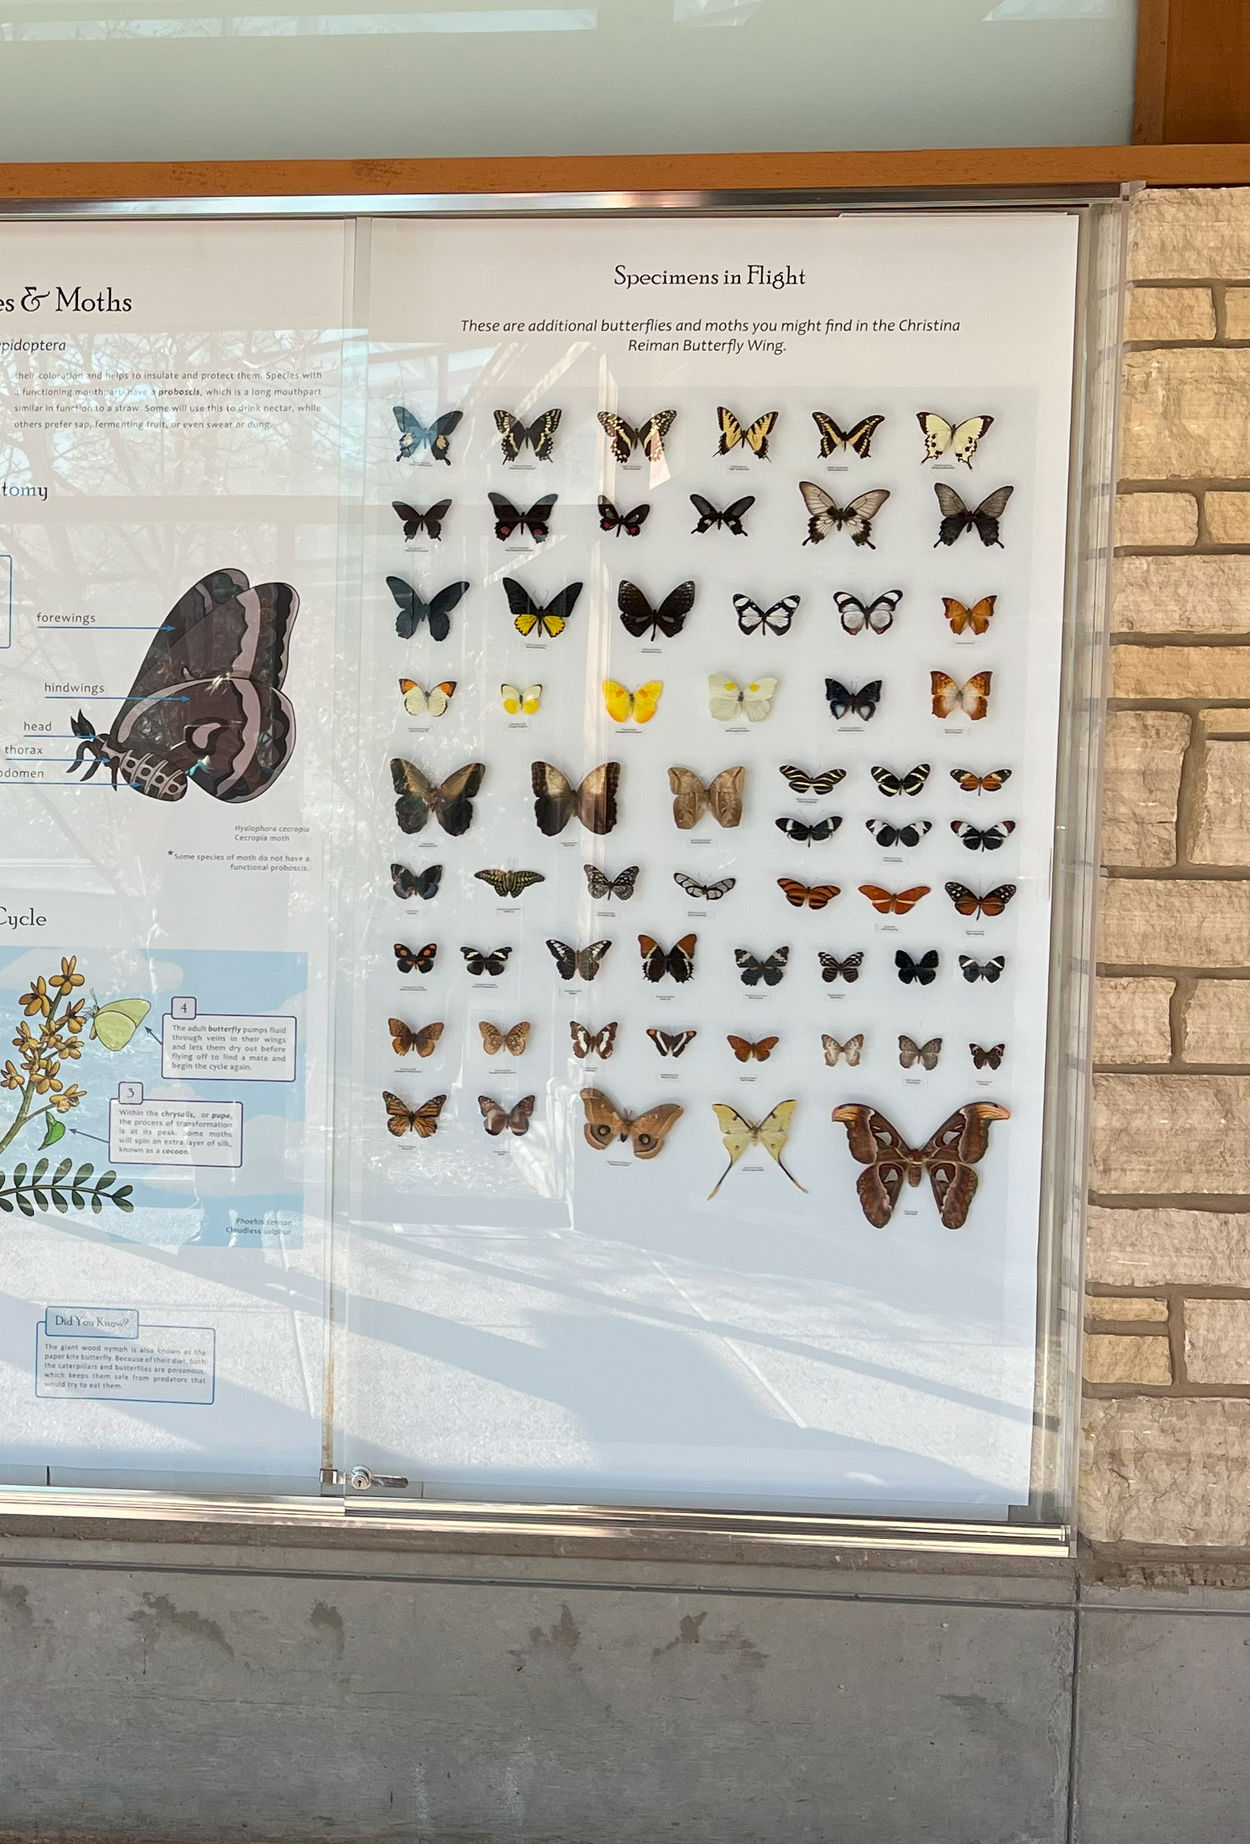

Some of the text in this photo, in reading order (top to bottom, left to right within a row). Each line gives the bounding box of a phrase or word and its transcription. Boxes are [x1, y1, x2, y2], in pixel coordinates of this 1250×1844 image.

[614, 264, 805, 290] Specimens in Flight
[20, 286, 50, 312] &
[55, 286, 131, 312] Moths
[461, 318, 960, 335] These are additional butterflies and moths you might find in the Christina
[628, 338, 786, 355] Reiman Butterfly Wing.
[36, 612, 95, 627] forewings
[44, 682, 104, 696] hindwings
[23, 721, 51, 731] head
[5, 744, 42, 754] thorax
[234, 824, 310, 834] Hyalophora cecropia
[234, 834, 267, 842] Cecropia
[197, 853, 225, 862] species
[226, 853, 235, 861] of
[258, 854, 268, 862] do
[270, 854, 283, 862] not
[270, 864, 308, 872] proboscis.
[181, 1003, 187, 1013] 4
[207, 1025, 241, 1034] butterfly
[269, 1026, 286, 1034] fluid
[172, 1034, 202, 1043] through
[128, 1088, 134, 1098] 3
[55, 1315, 129, 1328] Did You Know?
